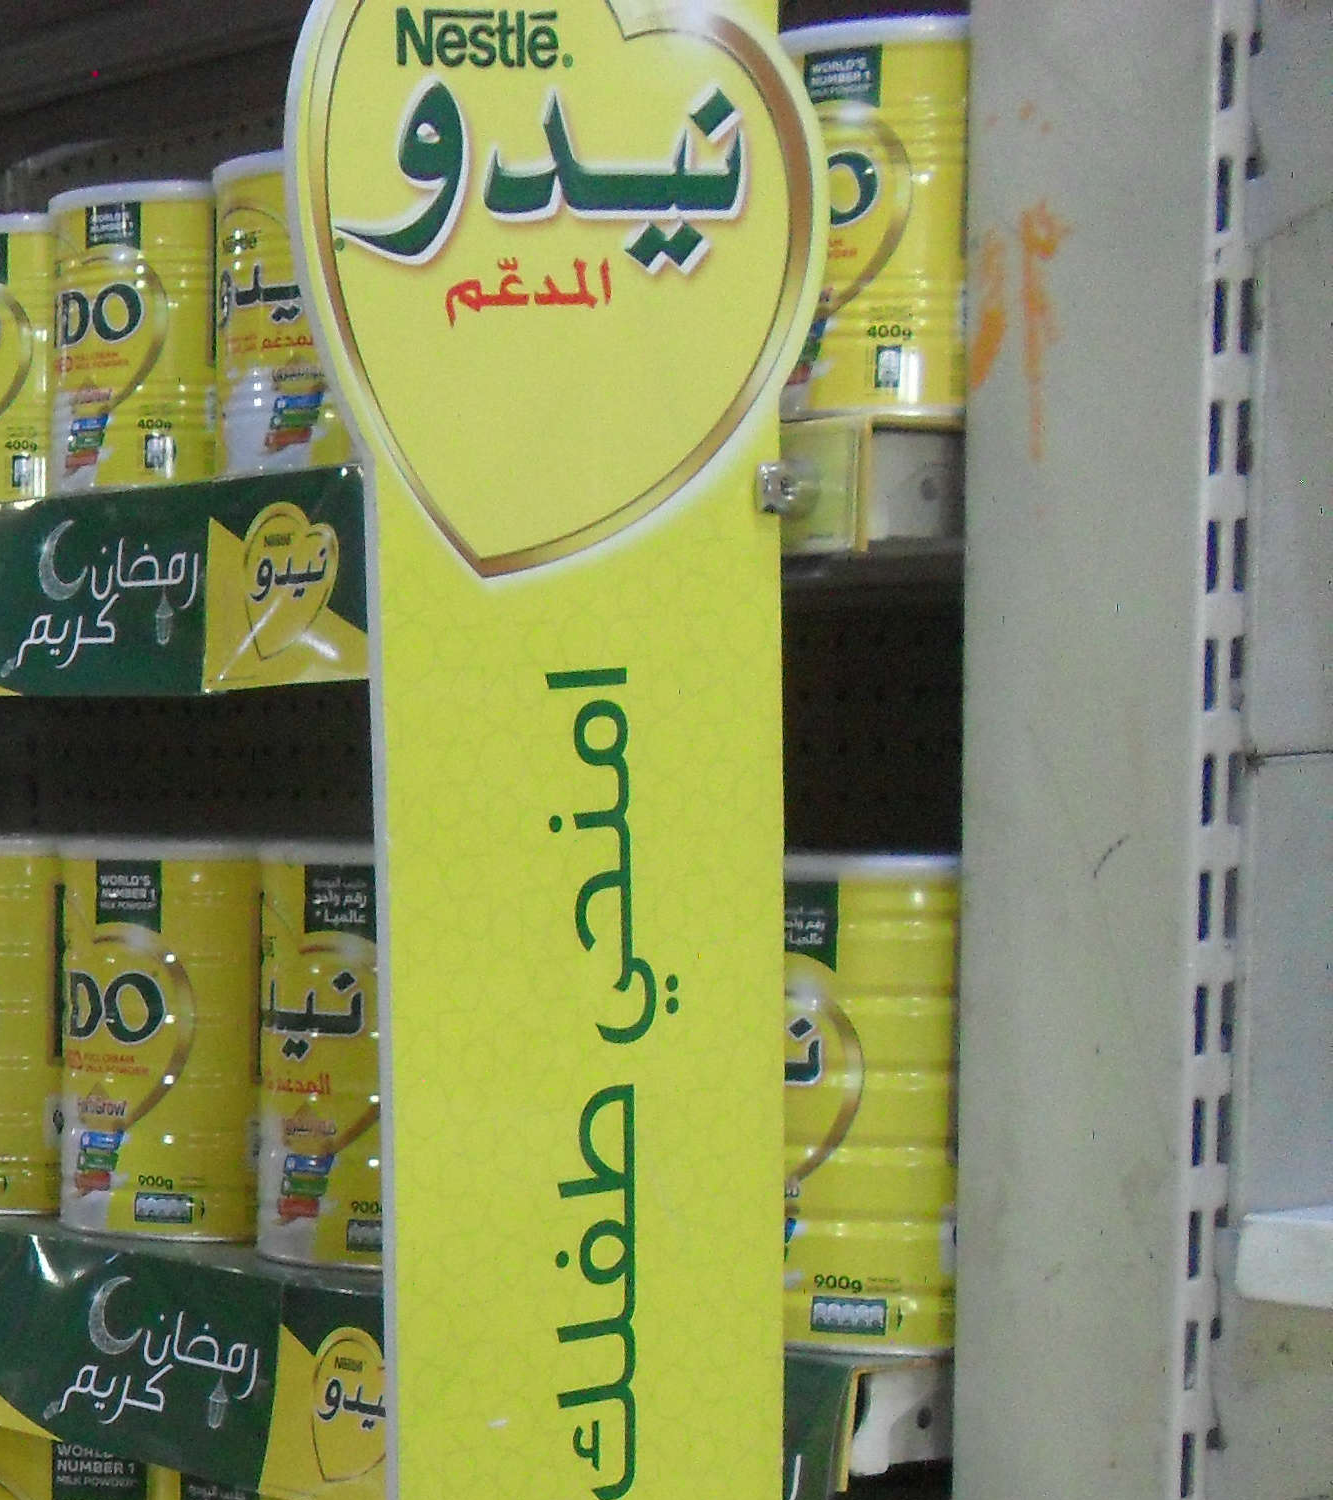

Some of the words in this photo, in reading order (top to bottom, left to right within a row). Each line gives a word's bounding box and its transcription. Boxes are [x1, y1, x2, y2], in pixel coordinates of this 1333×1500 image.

[336, 80, 742, 270] نيدو
[867, 325, 912, 340] 400g
[86, 536, 199, 608] رمضان
[251, 545, 330, 601] نيدو
[15, 605, 117, 670] كريم
[100, 874, 151, 887] WORLD'S
[546, 667, 678, 1043] امنحي
[138, 1175, 173, 1191] 900g
[813, 1274, 863, 1294] 900g
[139, 1310, 260, 1400] رمضان
[61, 1361, 175, 1426] كريم
[56, 1459, 123, 1475] NUMBER
